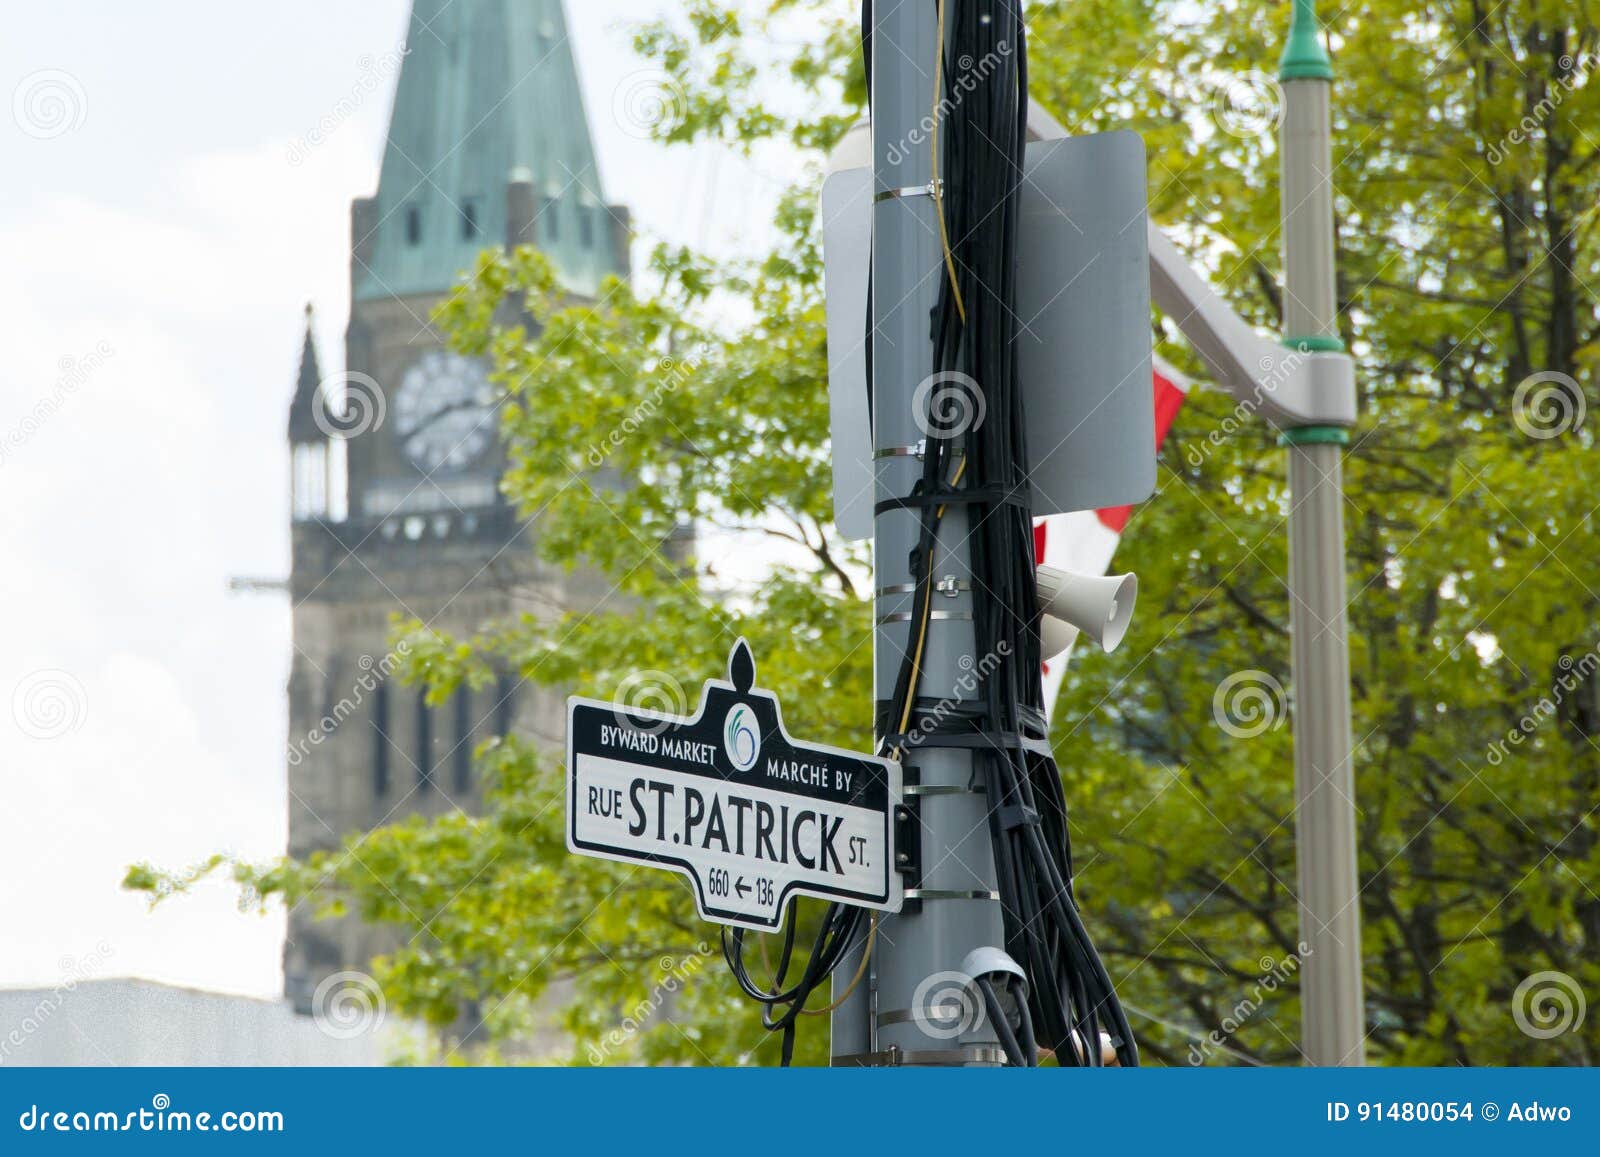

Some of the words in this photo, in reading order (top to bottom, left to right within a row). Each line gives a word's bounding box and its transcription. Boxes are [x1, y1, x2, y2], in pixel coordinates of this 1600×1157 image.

[601, 724, 658, 754] BYWARD
[661, 737, 717, 765] MARKET
[767, 758, 829, 788] MARCHÉ
[835, 770, 852, 792] BY
[588, 785, 622, 819] RUE
[848, 836, 870, 867] ST.
[709, 867, 729, 897] 660
[756, 877, 774, 907] 136
